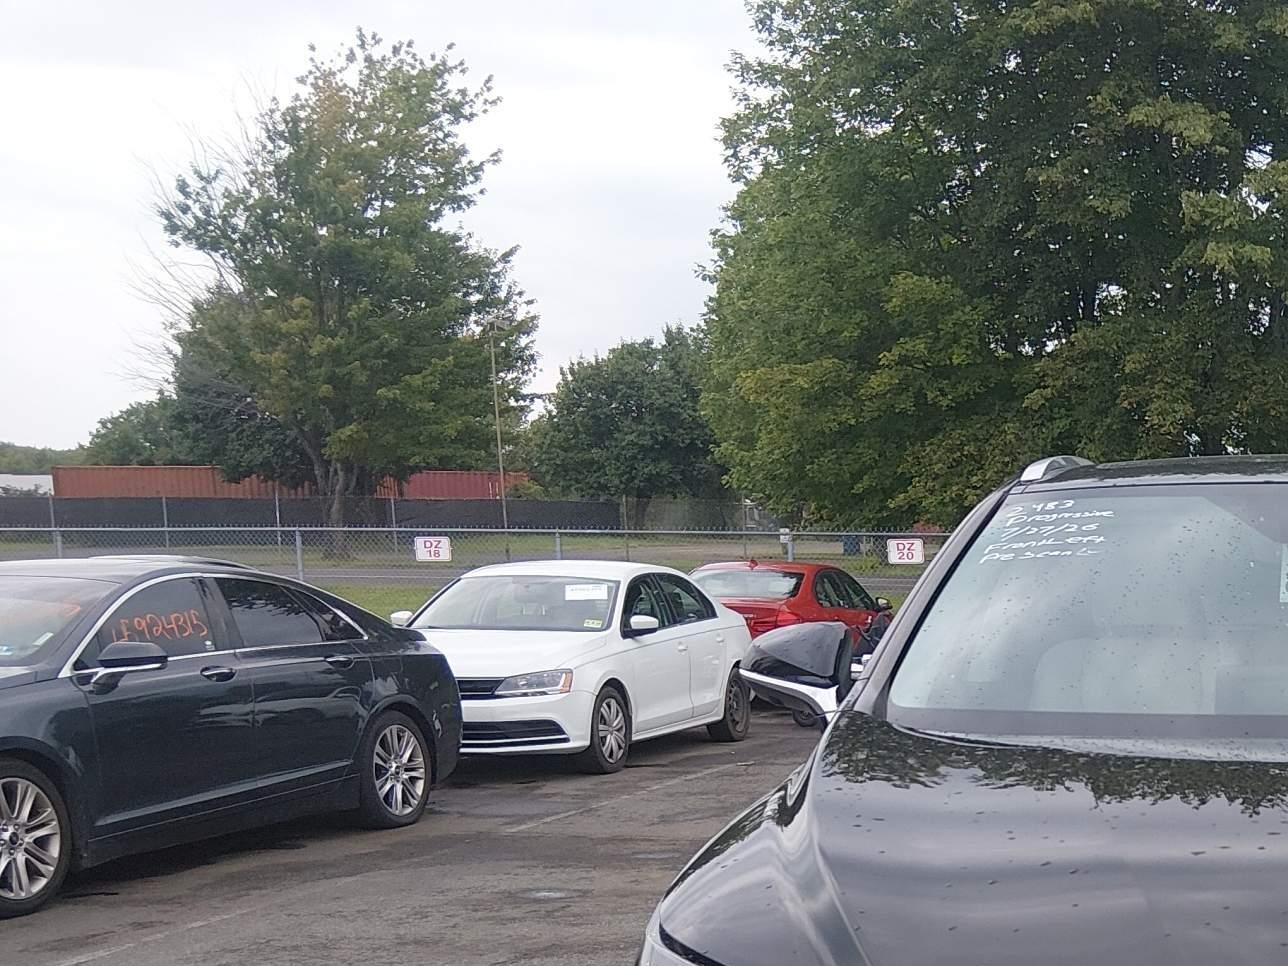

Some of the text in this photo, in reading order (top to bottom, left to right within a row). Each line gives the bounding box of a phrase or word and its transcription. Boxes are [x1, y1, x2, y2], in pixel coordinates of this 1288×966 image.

[1000, 523, 1100, 541] 7/27/26
[423, 540, 442, 549] DZ
[896, 542, 915, 551] DZ
[427, 550, 441, 558] 18
[897, 552, 914, 560] 20
